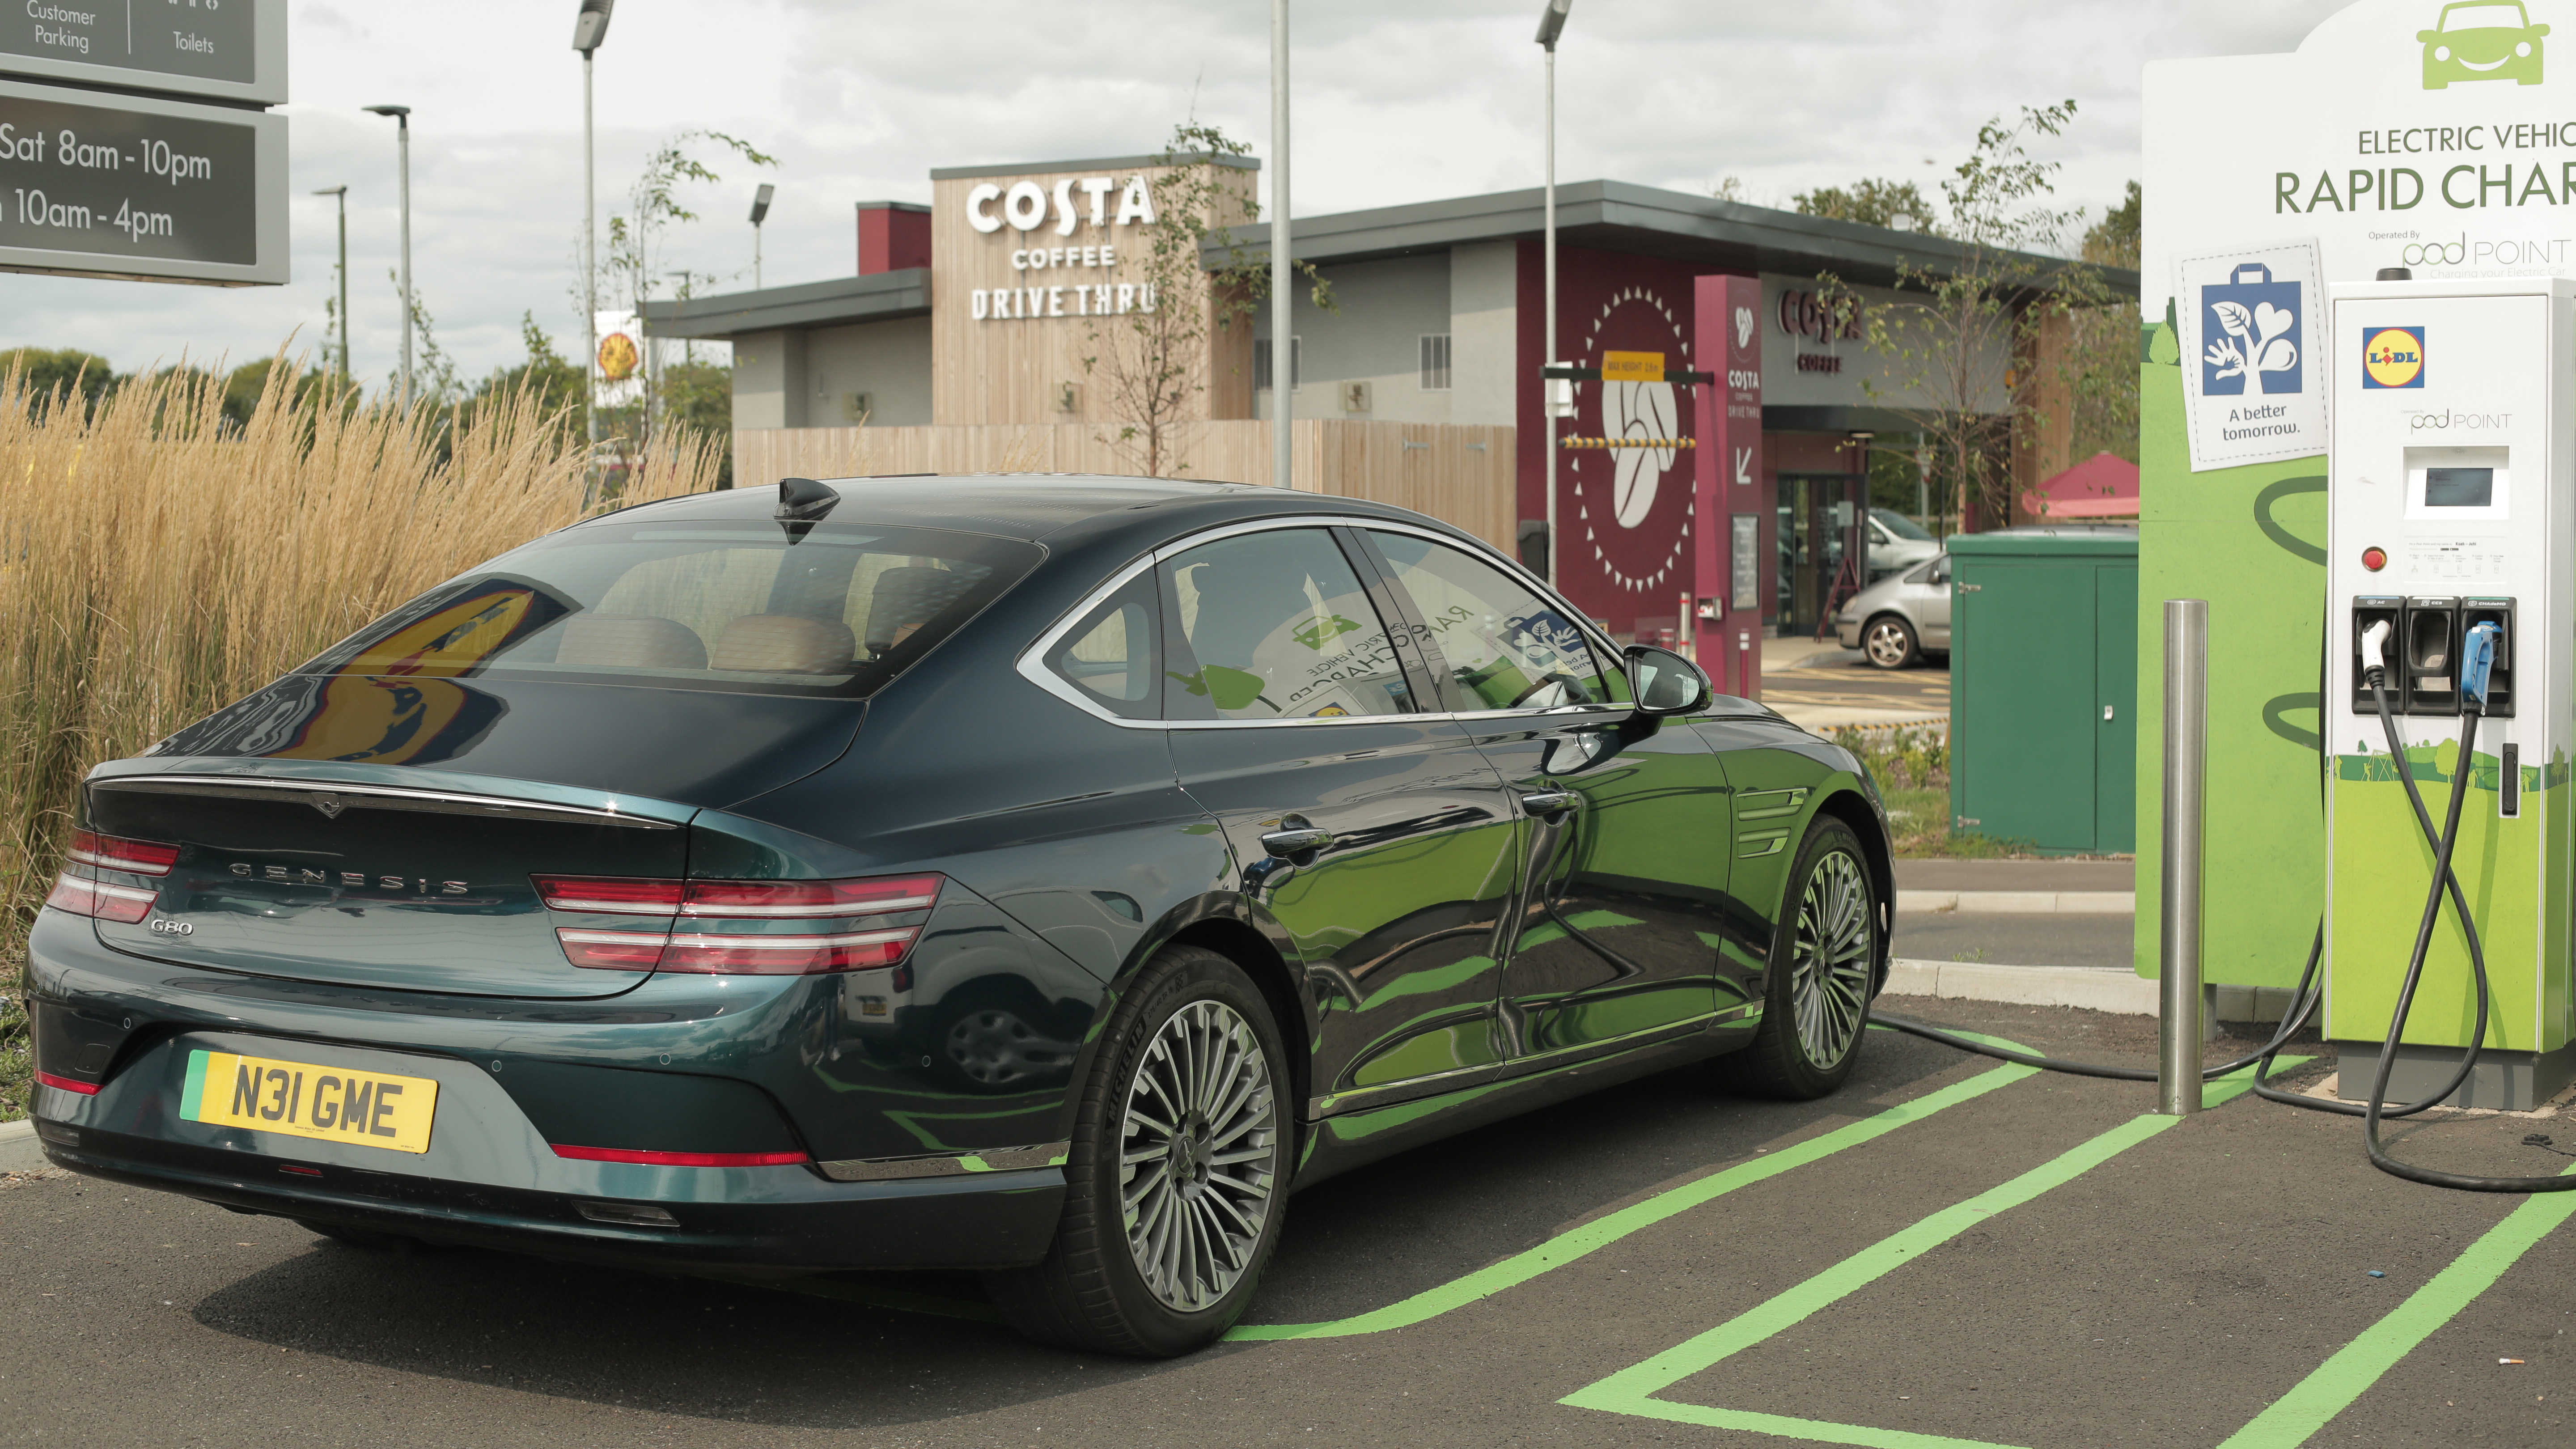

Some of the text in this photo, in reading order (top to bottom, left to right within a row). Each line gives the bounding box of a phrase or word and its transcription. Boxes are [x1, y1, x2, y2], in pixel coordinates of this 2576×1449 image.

[27, 0, 96, 25] Customer
[35, 25, 89, 54] Parking
[173, 31, 214, 54] Toilets
[2359, 125, 2483, 154] ELECTRIC
[0, 123, 45, 162] Sat
[58, 129, 118, 170] 8am
[140, 139, 211, 186] 10pm
[2275, 168, 2424, 214] RAPID
[15, 188, 90, 229] 10am
[114, 198, 173, 242] 4pm
[966, 175, 1157, 237] COSTA
[2368, 230, 2420, 241] Operated By
[2402, 231, 2572, 268] pod POINT
[1012, 245, 1116, 270] COFFEE
[2508, 267, 2545, 277] Electric
[2548, 267, 2565, 276] Car
[971, 282, 1157, 320] DRIVE THRU
[1728, 369, 1759, 391] COSTA
[2229, 404, 2287, 422] A better
[2411, 408, 2512, 435] pod POINT
[2223, 422, 2300, 441] tomorrow.
[229, 863, 468, 894] GENESIS
[151, 919, 194, 936] G80
[1107, 1021, 1144, 1123] MICHELIN
[232, 1064, 403, 1138] N31 GME
